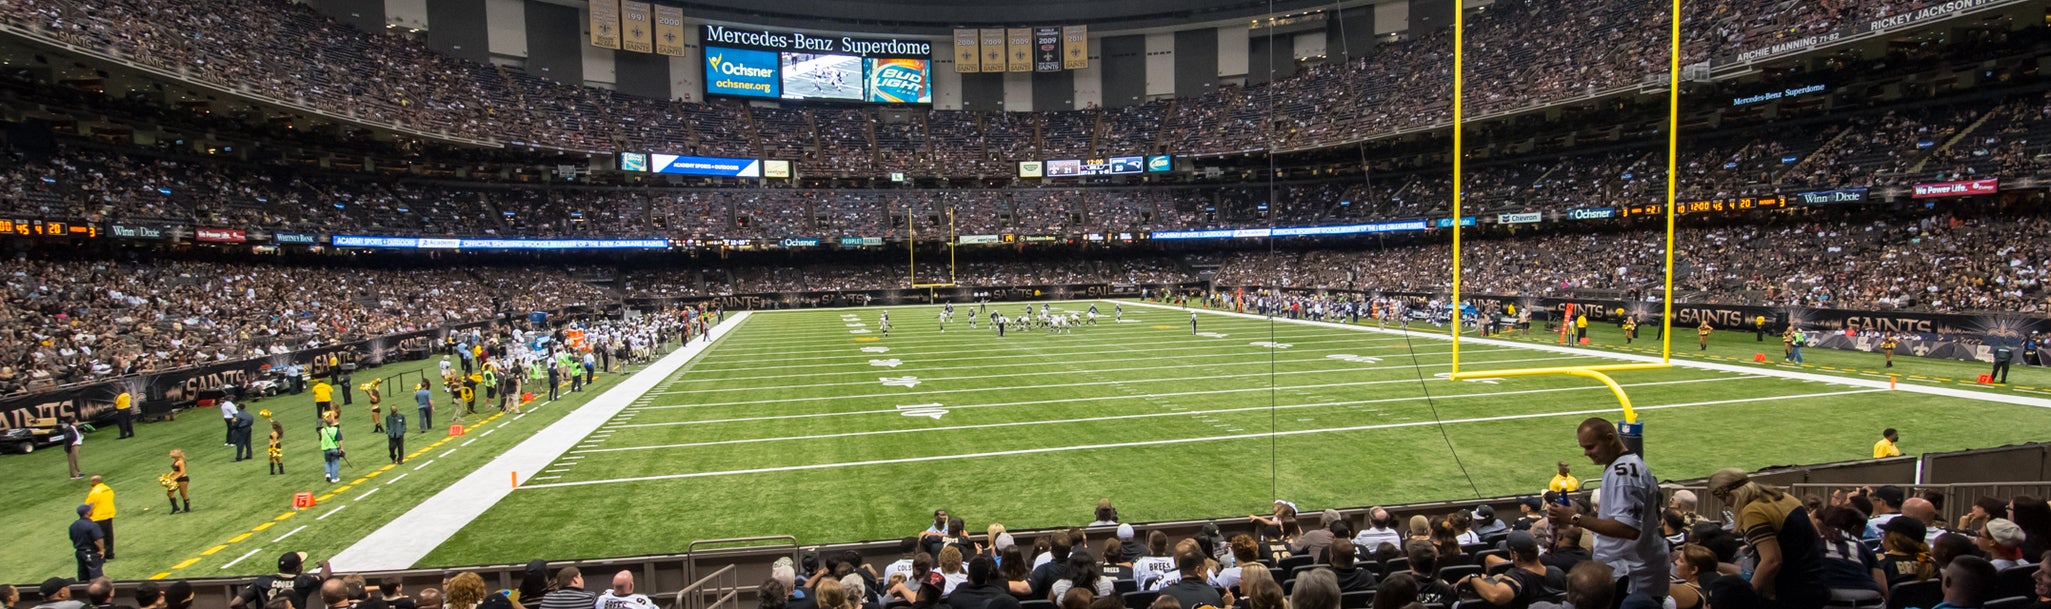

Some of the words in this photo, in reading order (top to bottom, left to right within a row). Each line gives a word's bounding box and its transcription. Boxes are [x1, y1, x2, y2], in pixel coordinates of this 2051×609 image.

[627, 13, 645, 21] 1991
[1870, 12, 1912, 31] RICKEY
[1914, 0, 1973, 20] JACKSON
[659, 17, 680, 26] 2000
[58, 31, 93, 49] SAINTS
[706, 25, 833, 51] Mercedes-Benz
[841, 37, 930, 56] Superdome
[625, 43, 651, 52] SAINTS
[658, 46, 683, 56] SAINTS
[1736, 46, 1769, 62] ARCHIE
[1771, 36, 1818, 54] MANNING
[1818, 32, 1840, 43] 71-82
[721, 61, 773, 79] Ochsner
[882, 68, 922, 83] BUD
[716, 80, 771, 93] ochsner.org
[875, 77, 923, 92] LIGHT
[1733, 90, 1782, 106] Mercedes-Benz
[1785, 83, 1825, 97] Superdome
[1915, 186, 1926, 195] We
[1926, 184, 1950, 195] Power
[1740, 198, 1750, 208] 20
[1779, 198, 1785, 207] 3
[1804, 194, 1828, 204] Winn
[1835, 192, 1860, 202] Dixie
[1677, 204, 1685, 214] 10
[1690, 201, 1710, 212] 12:00
[1713, 201, 1723, 211] 45
[1729, 201, 1735, 210] 4
[1511, 214, 1538, 222] Chevron
[1575, 208, 1610, 219] Ochsner
[1622, 208, 1628, 217] 3
[16, 224, 29, 235] 45
[35, 225, 43, 235] 4
[48, 223, 61, 234] 20
[88, 227, 96, 238] 3
[112, 225, 135, 237] Winn
[140, 226, 160, 238] Dixie
[336, 237, 364, 245] ACADEMY
[785, 238, 816, 246] Ochsner
[713, 296, 760, 308] SAINTS
[1557, 303, 1604, 318] SINTS
[1680, 307, 1742, 327] SAINTS
[1846, 316, 1932, 333] SAINTS
[186, 369, 247, 401] SAINTS
[1613, 462, 1640, 478] 51
[897, 564, 912, 572] COLS
[1148, 562, 1171, 572] BREES
